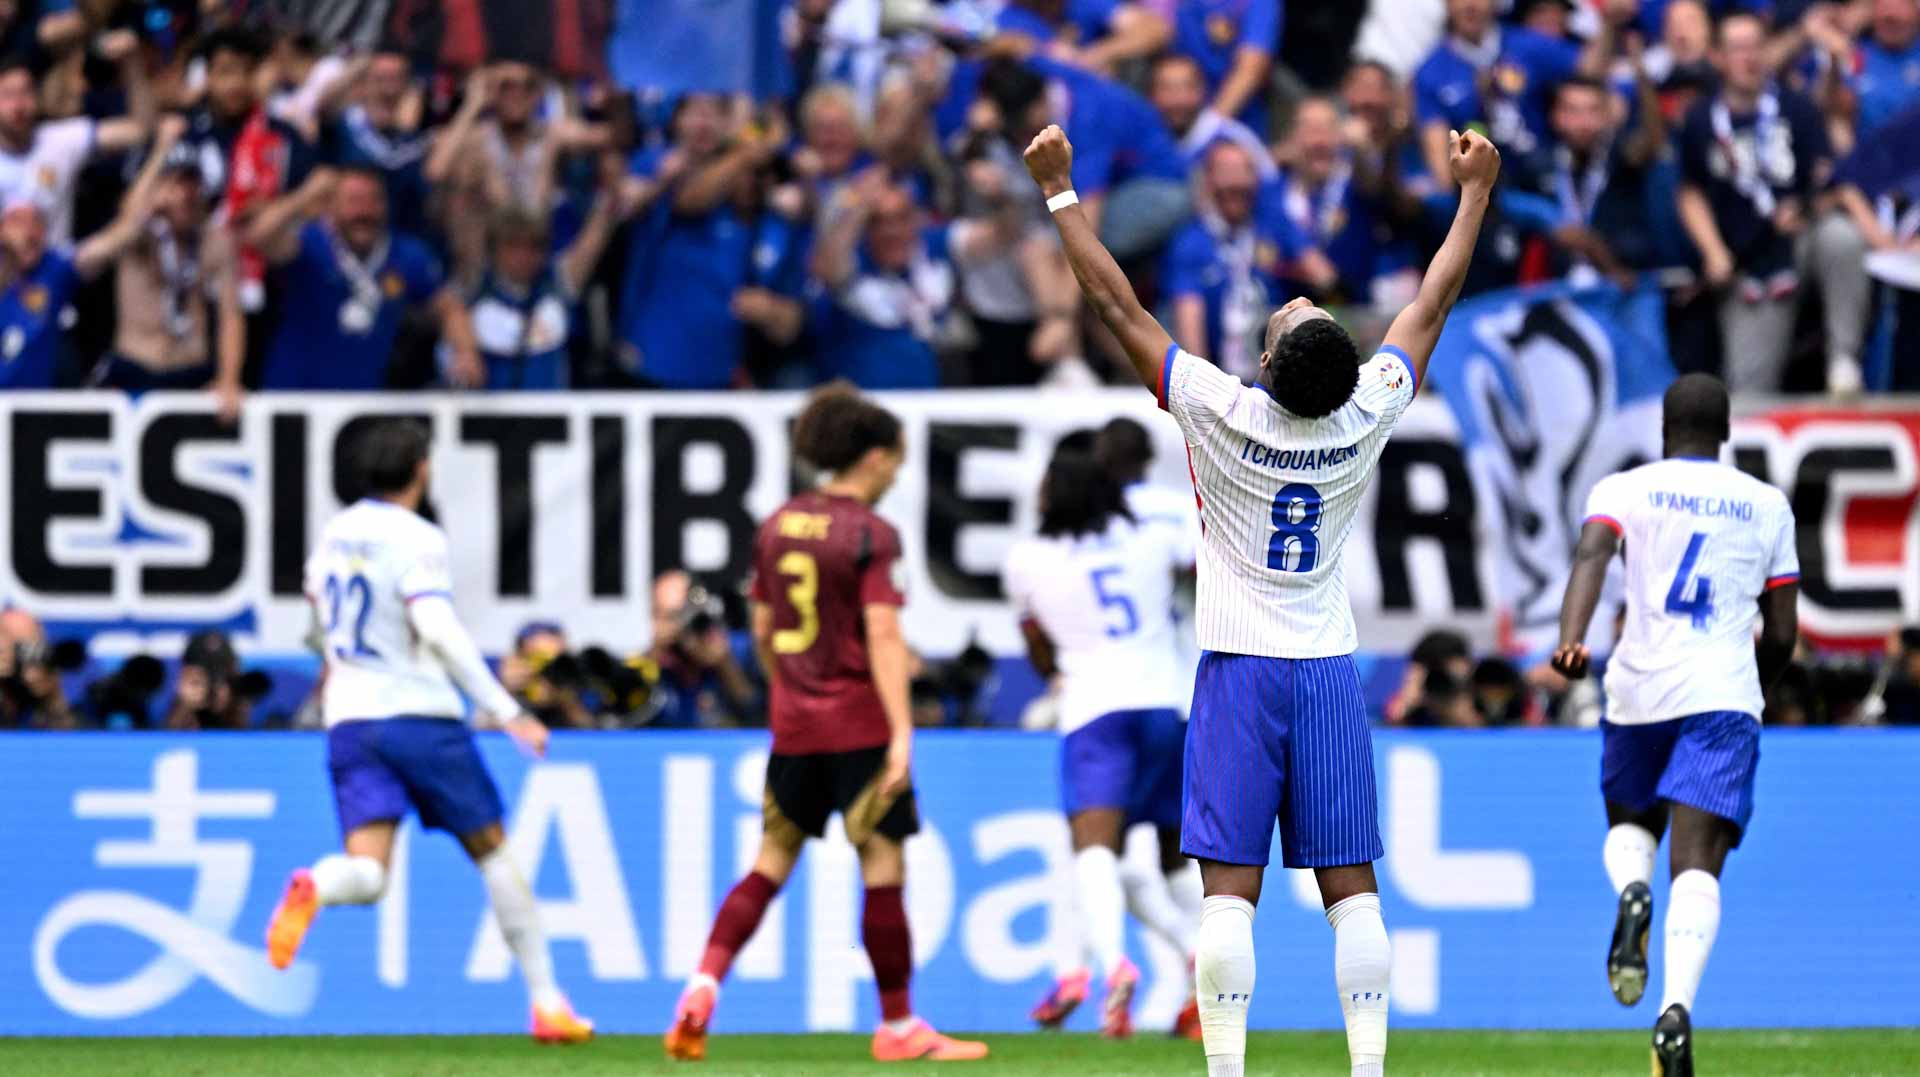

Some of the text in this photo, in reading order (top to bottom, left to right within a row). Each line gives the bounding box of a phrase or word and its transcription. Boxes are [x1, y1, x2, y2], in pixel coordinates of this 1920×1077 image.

[1241, 437, 1359, 471] TCHOUAMENI
[1267, 482, 1325, 573] 8
[1649, 490, 1753, 522] UPAMECANO
[325, 573, 383, 659] 22
[772, 551, 820, 654] 3
[1089, 565, 1140, 637] 5
[1664, 531, 1715, 630] 4
